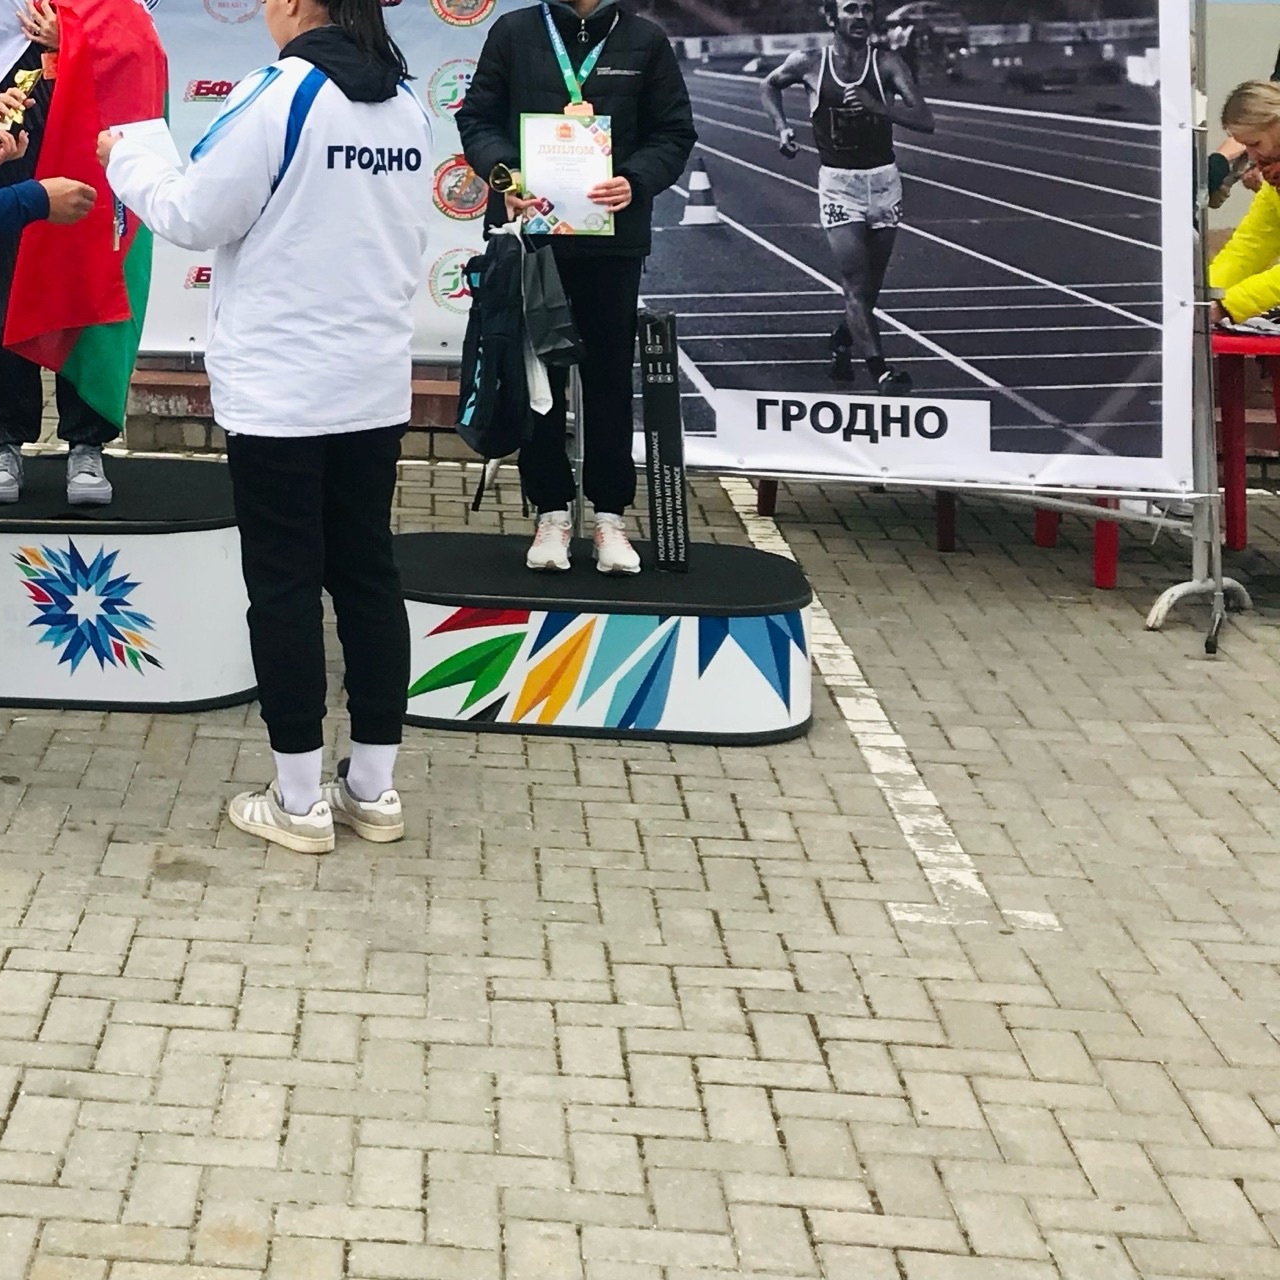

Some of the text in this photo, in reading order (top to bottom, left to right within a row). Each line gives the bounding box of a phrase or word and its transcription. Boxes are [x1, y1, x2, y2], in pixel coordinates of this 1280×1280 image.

[326, 145, 422, 175] ГРОДНО
[538, 144, 595, 156] ДИПЛОМ
[756, 398, 949, 444] ГРОДНО
[651, 430, 661, 473] FRAGRANCE
[663, 464, 672, 483] DUFT
[673, 466, 683, 509] FRAGRANCE
[654, 479, 662, 497] WITH
[655, 498, 663, 517] MATS
[665, 497, 674, 524] MATTEN
[656, 519, 666, 561] HOUSEHOLD
